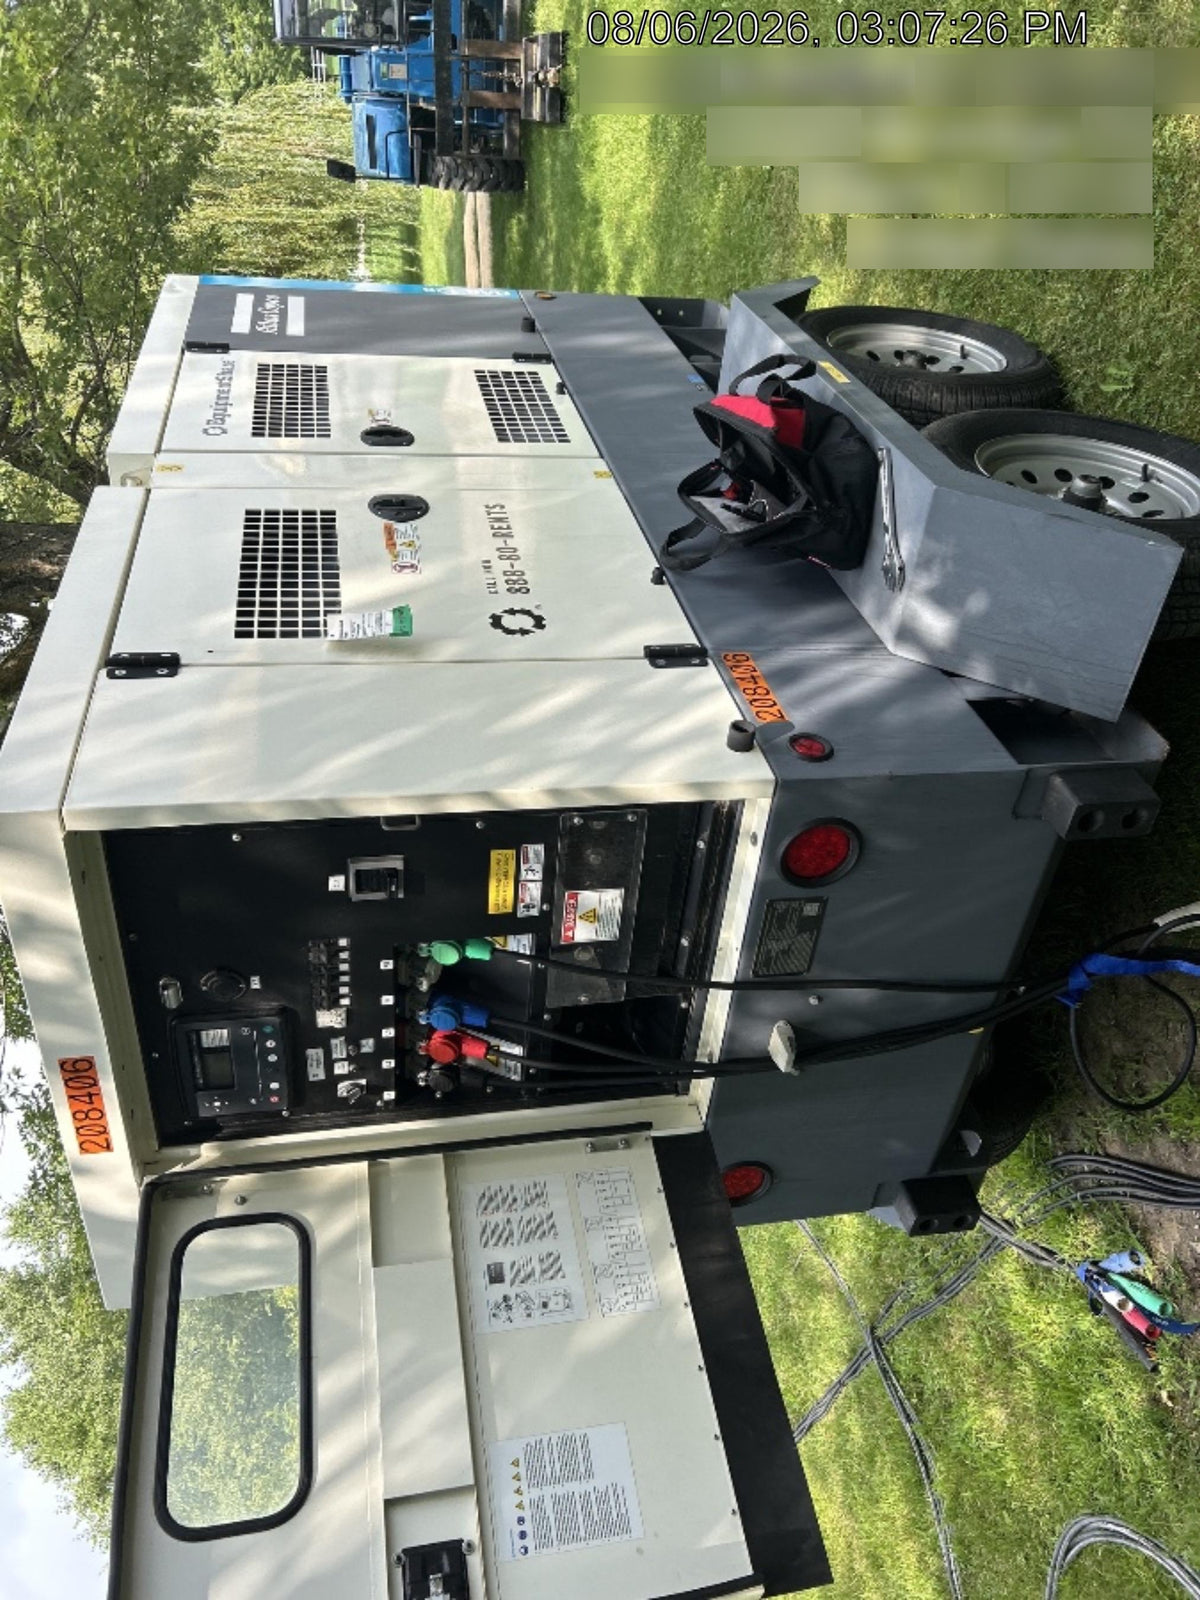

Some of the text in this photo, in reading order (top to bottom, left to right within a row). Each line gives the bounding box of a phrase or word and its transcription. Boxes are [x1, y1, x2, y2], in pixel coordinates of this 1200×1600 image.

[483, 503, 530, 595] 888-80-RENTS
[722, 652, 786, 722] 208406
[58, 1058, 110, 1152] 208406
